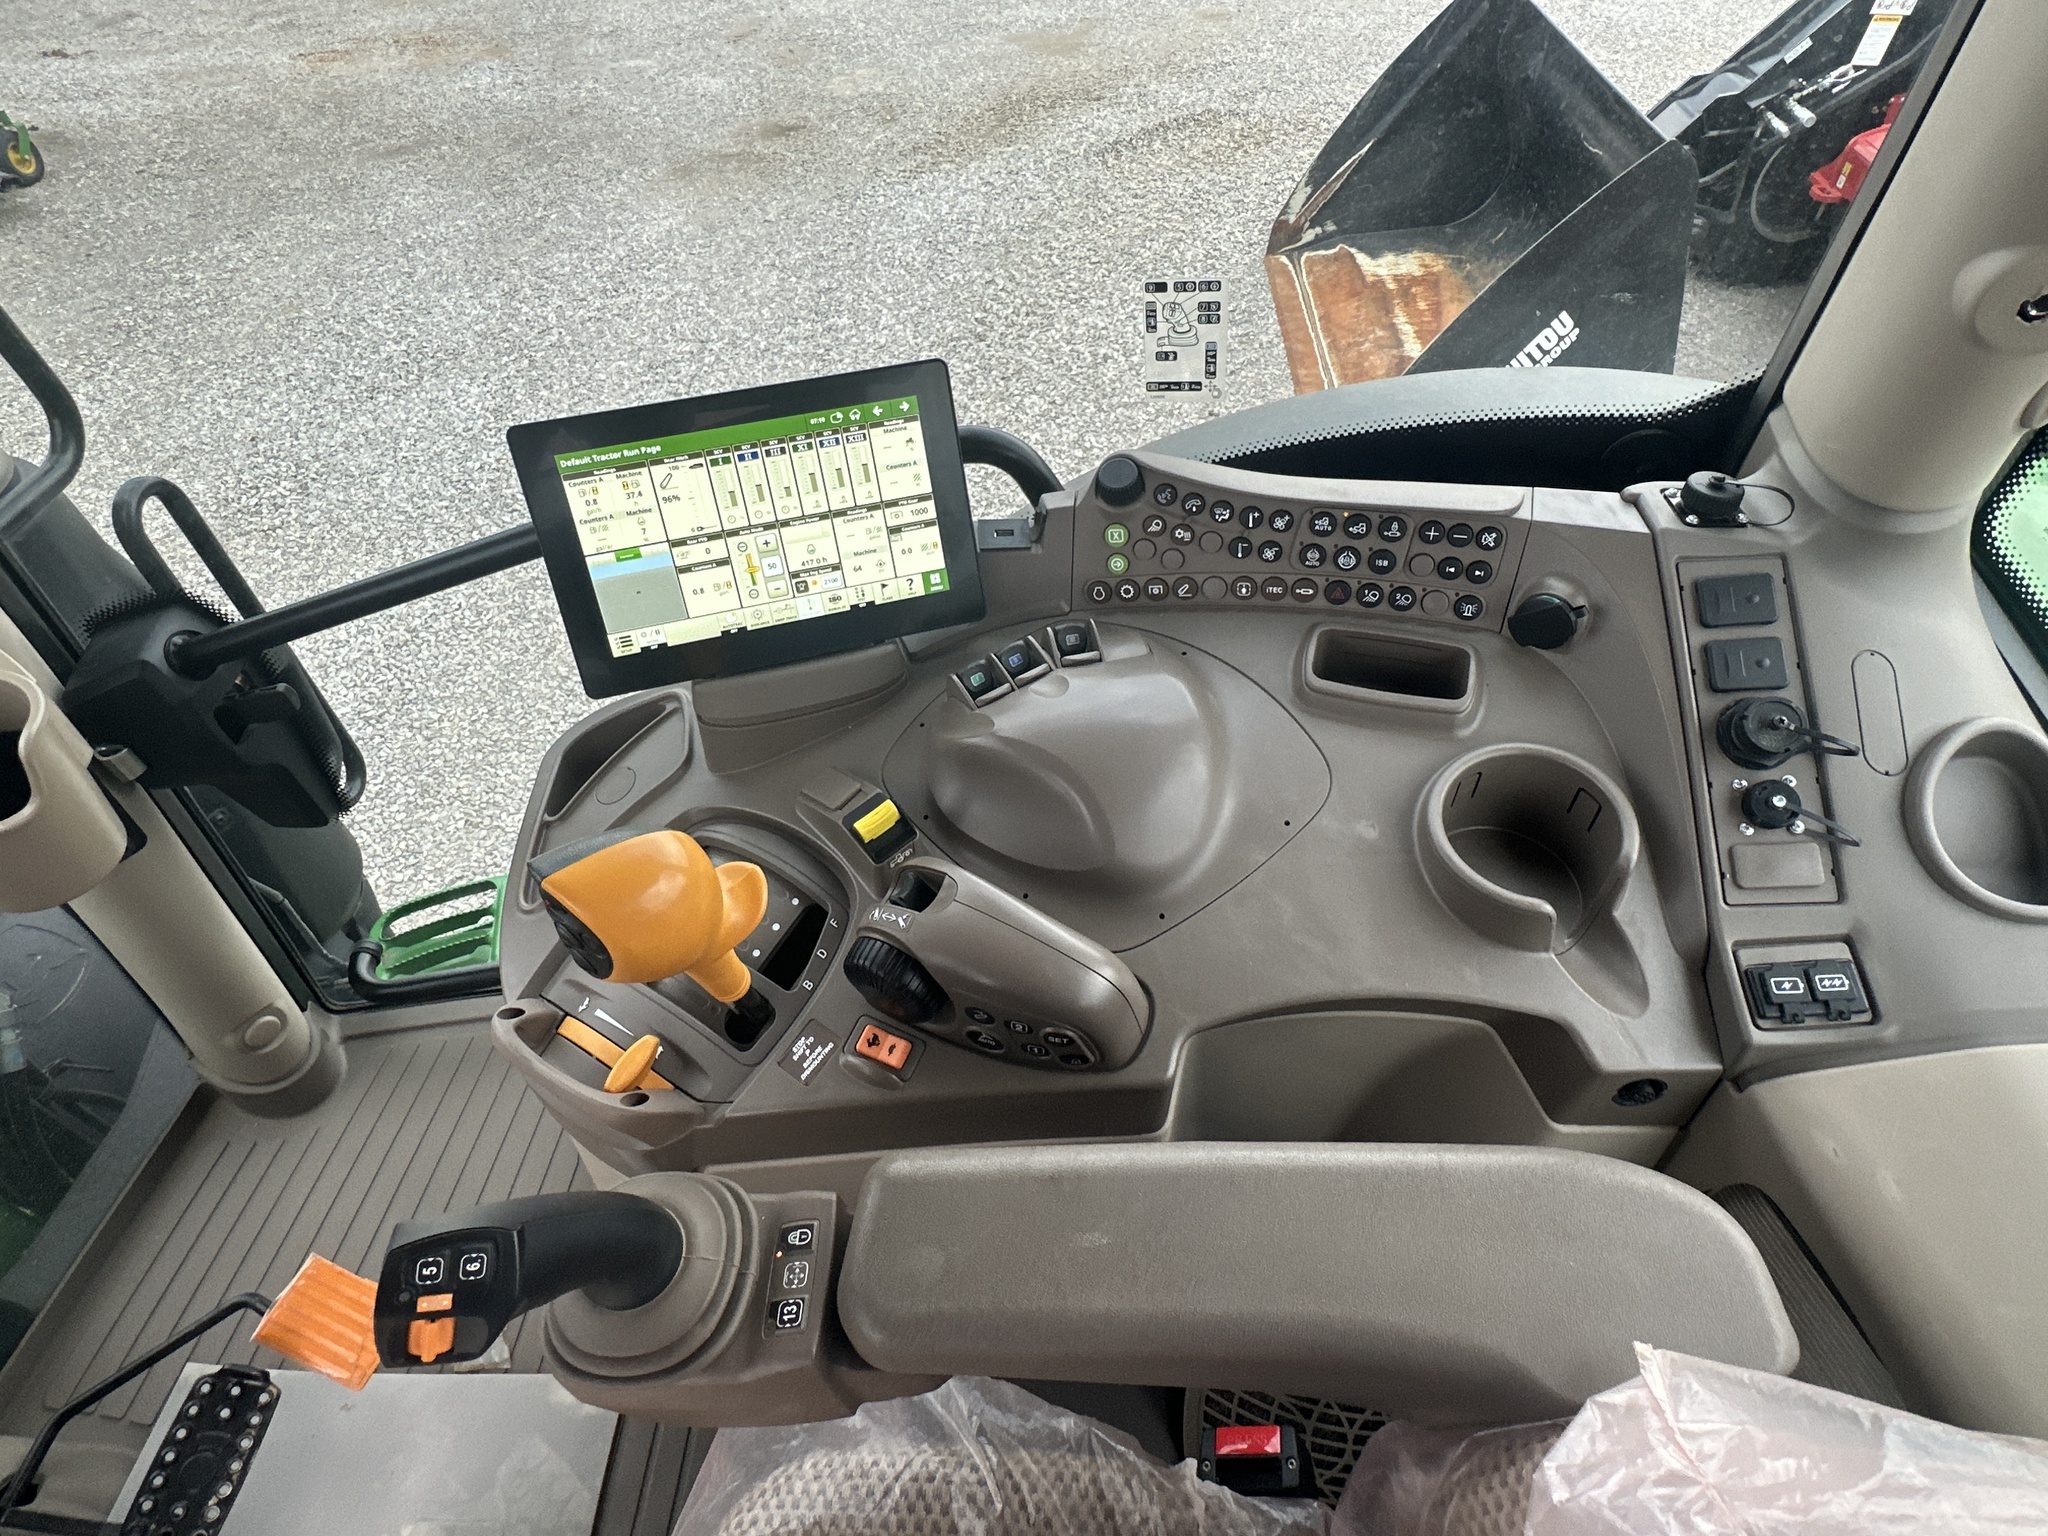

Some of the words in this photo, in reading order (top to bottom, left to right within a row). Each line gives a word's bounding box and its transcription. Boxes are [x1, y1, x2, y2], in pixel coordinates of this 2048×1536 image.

[882, 425, 907, 434] Machine
[822, 438, 836, 447] XII
[847, 433, 864, 442] XIII
[769, 447, 781, 455] III
[796, 443, 808, 451] XI
[559, 455, 592, 468] Default
[592, 450, 622, 462] Tractor
[622, 447, 639, 456] Run
[640, 443, 662, 456] Page
[744, 452, 752, 460] II
[885, 460, 911, 471] Counters
[615, 470, 642, 479] Machine
[567, 477, 597, 487] Counters
[624, 490, 643, 499] 37.4
[661, 493, 681, 503] 96%
[584, 498, 598, 506] 0.8
[625, 506, 652, 516] Machine
[910, 506, 928, 516] 1000
[578, 514, 608, 524] Counters
[842, 514, 868, 524] Counters
[853, 547, 877, 557] Machine
[767, 562, 777, 570] 50
[852, 564, 862, 572] 64
[692, 587, 704, 595] 0.8
[828, 595, 842, 603] ISO
[830, 918, 839, 928] F
[817, 949, 827, 959] D
[802, 980, 814, 991] B
[806, 1036, 815, 1045] TO
[1048, 1036, 1069, 1044] SET
[800, 1041, 834, 1080] DISMOUNTING
[803, 1045, 823, 1069] BEFORE
[422, 1266, 437, 1276] 5
[782, 1304, 797, 1322] 13
